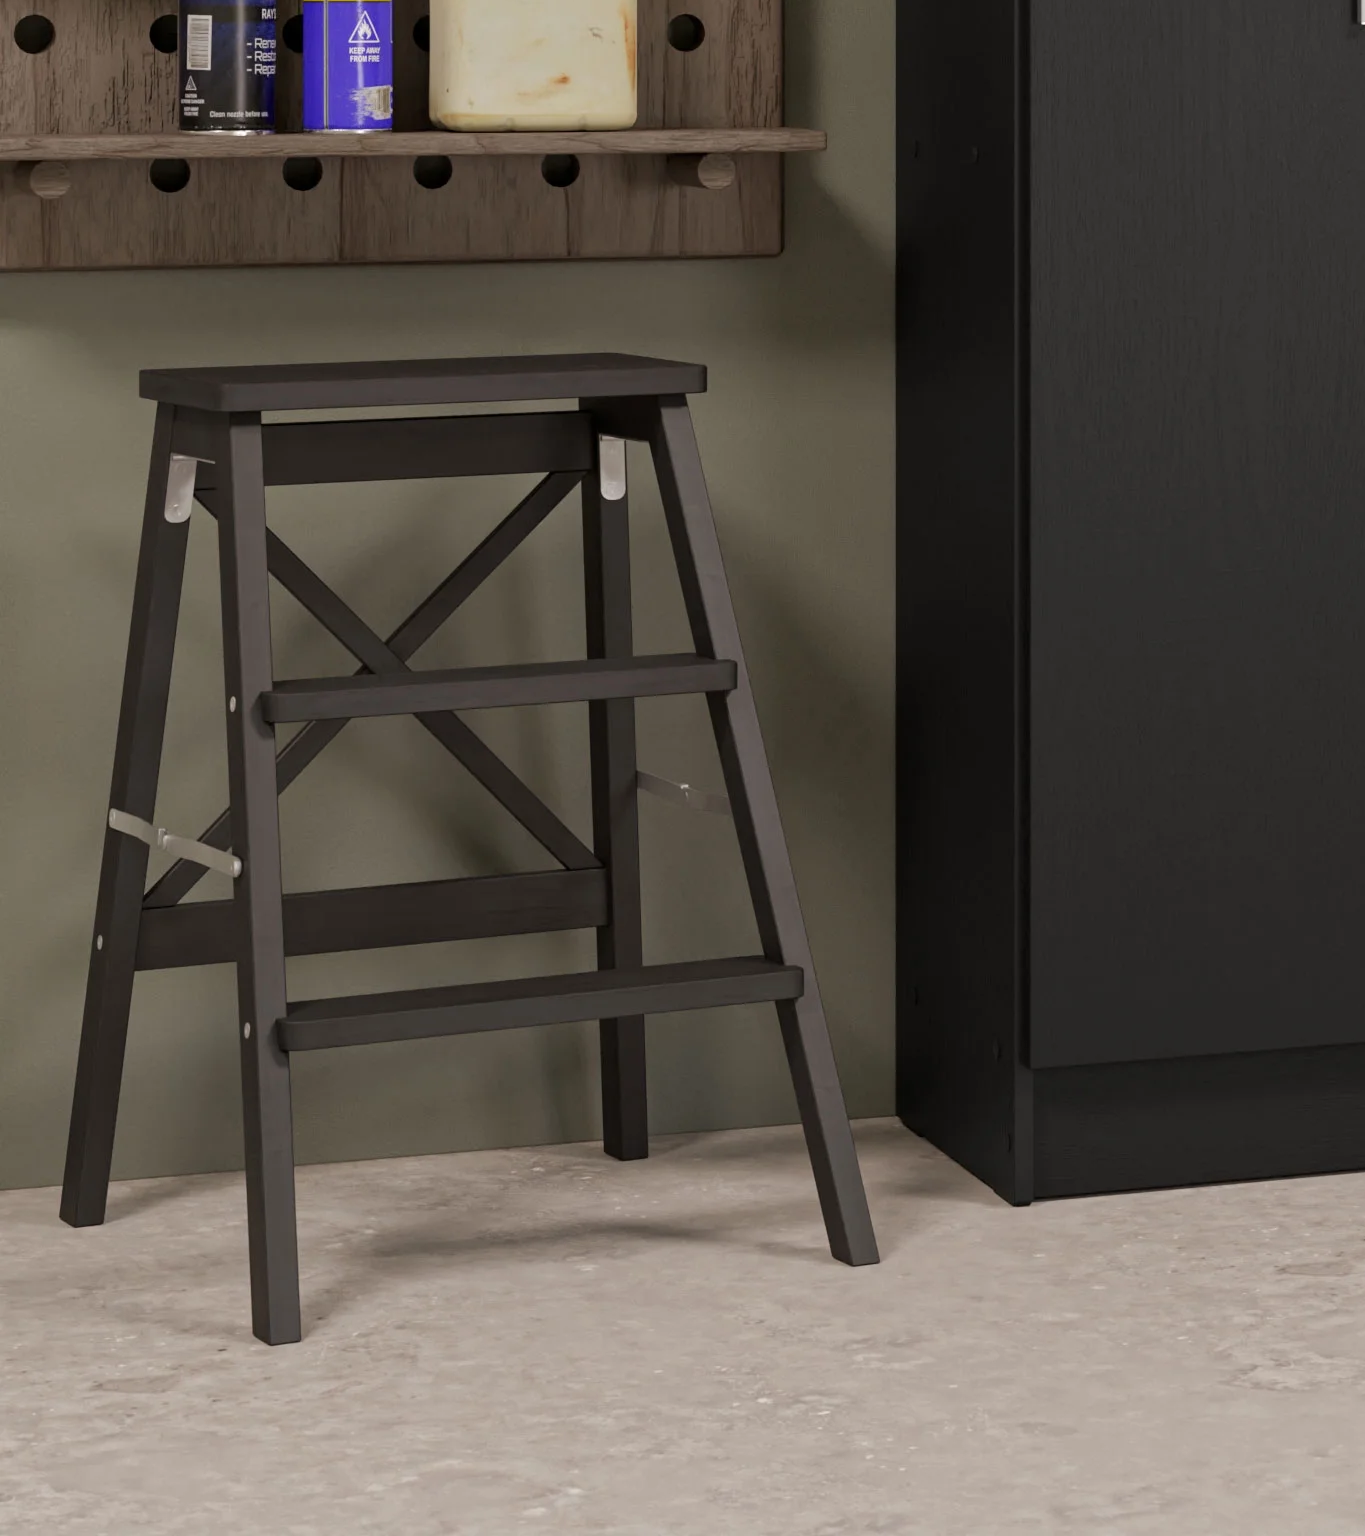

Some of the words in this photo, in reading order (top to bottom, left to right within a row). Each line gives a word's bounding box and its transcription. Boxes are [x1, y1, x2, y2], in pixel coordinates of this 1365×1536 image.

[350, 55, 367, 63] FROM
[368, 55, 380, 63] FIRE
[209, 110, 226, 118] Clean
